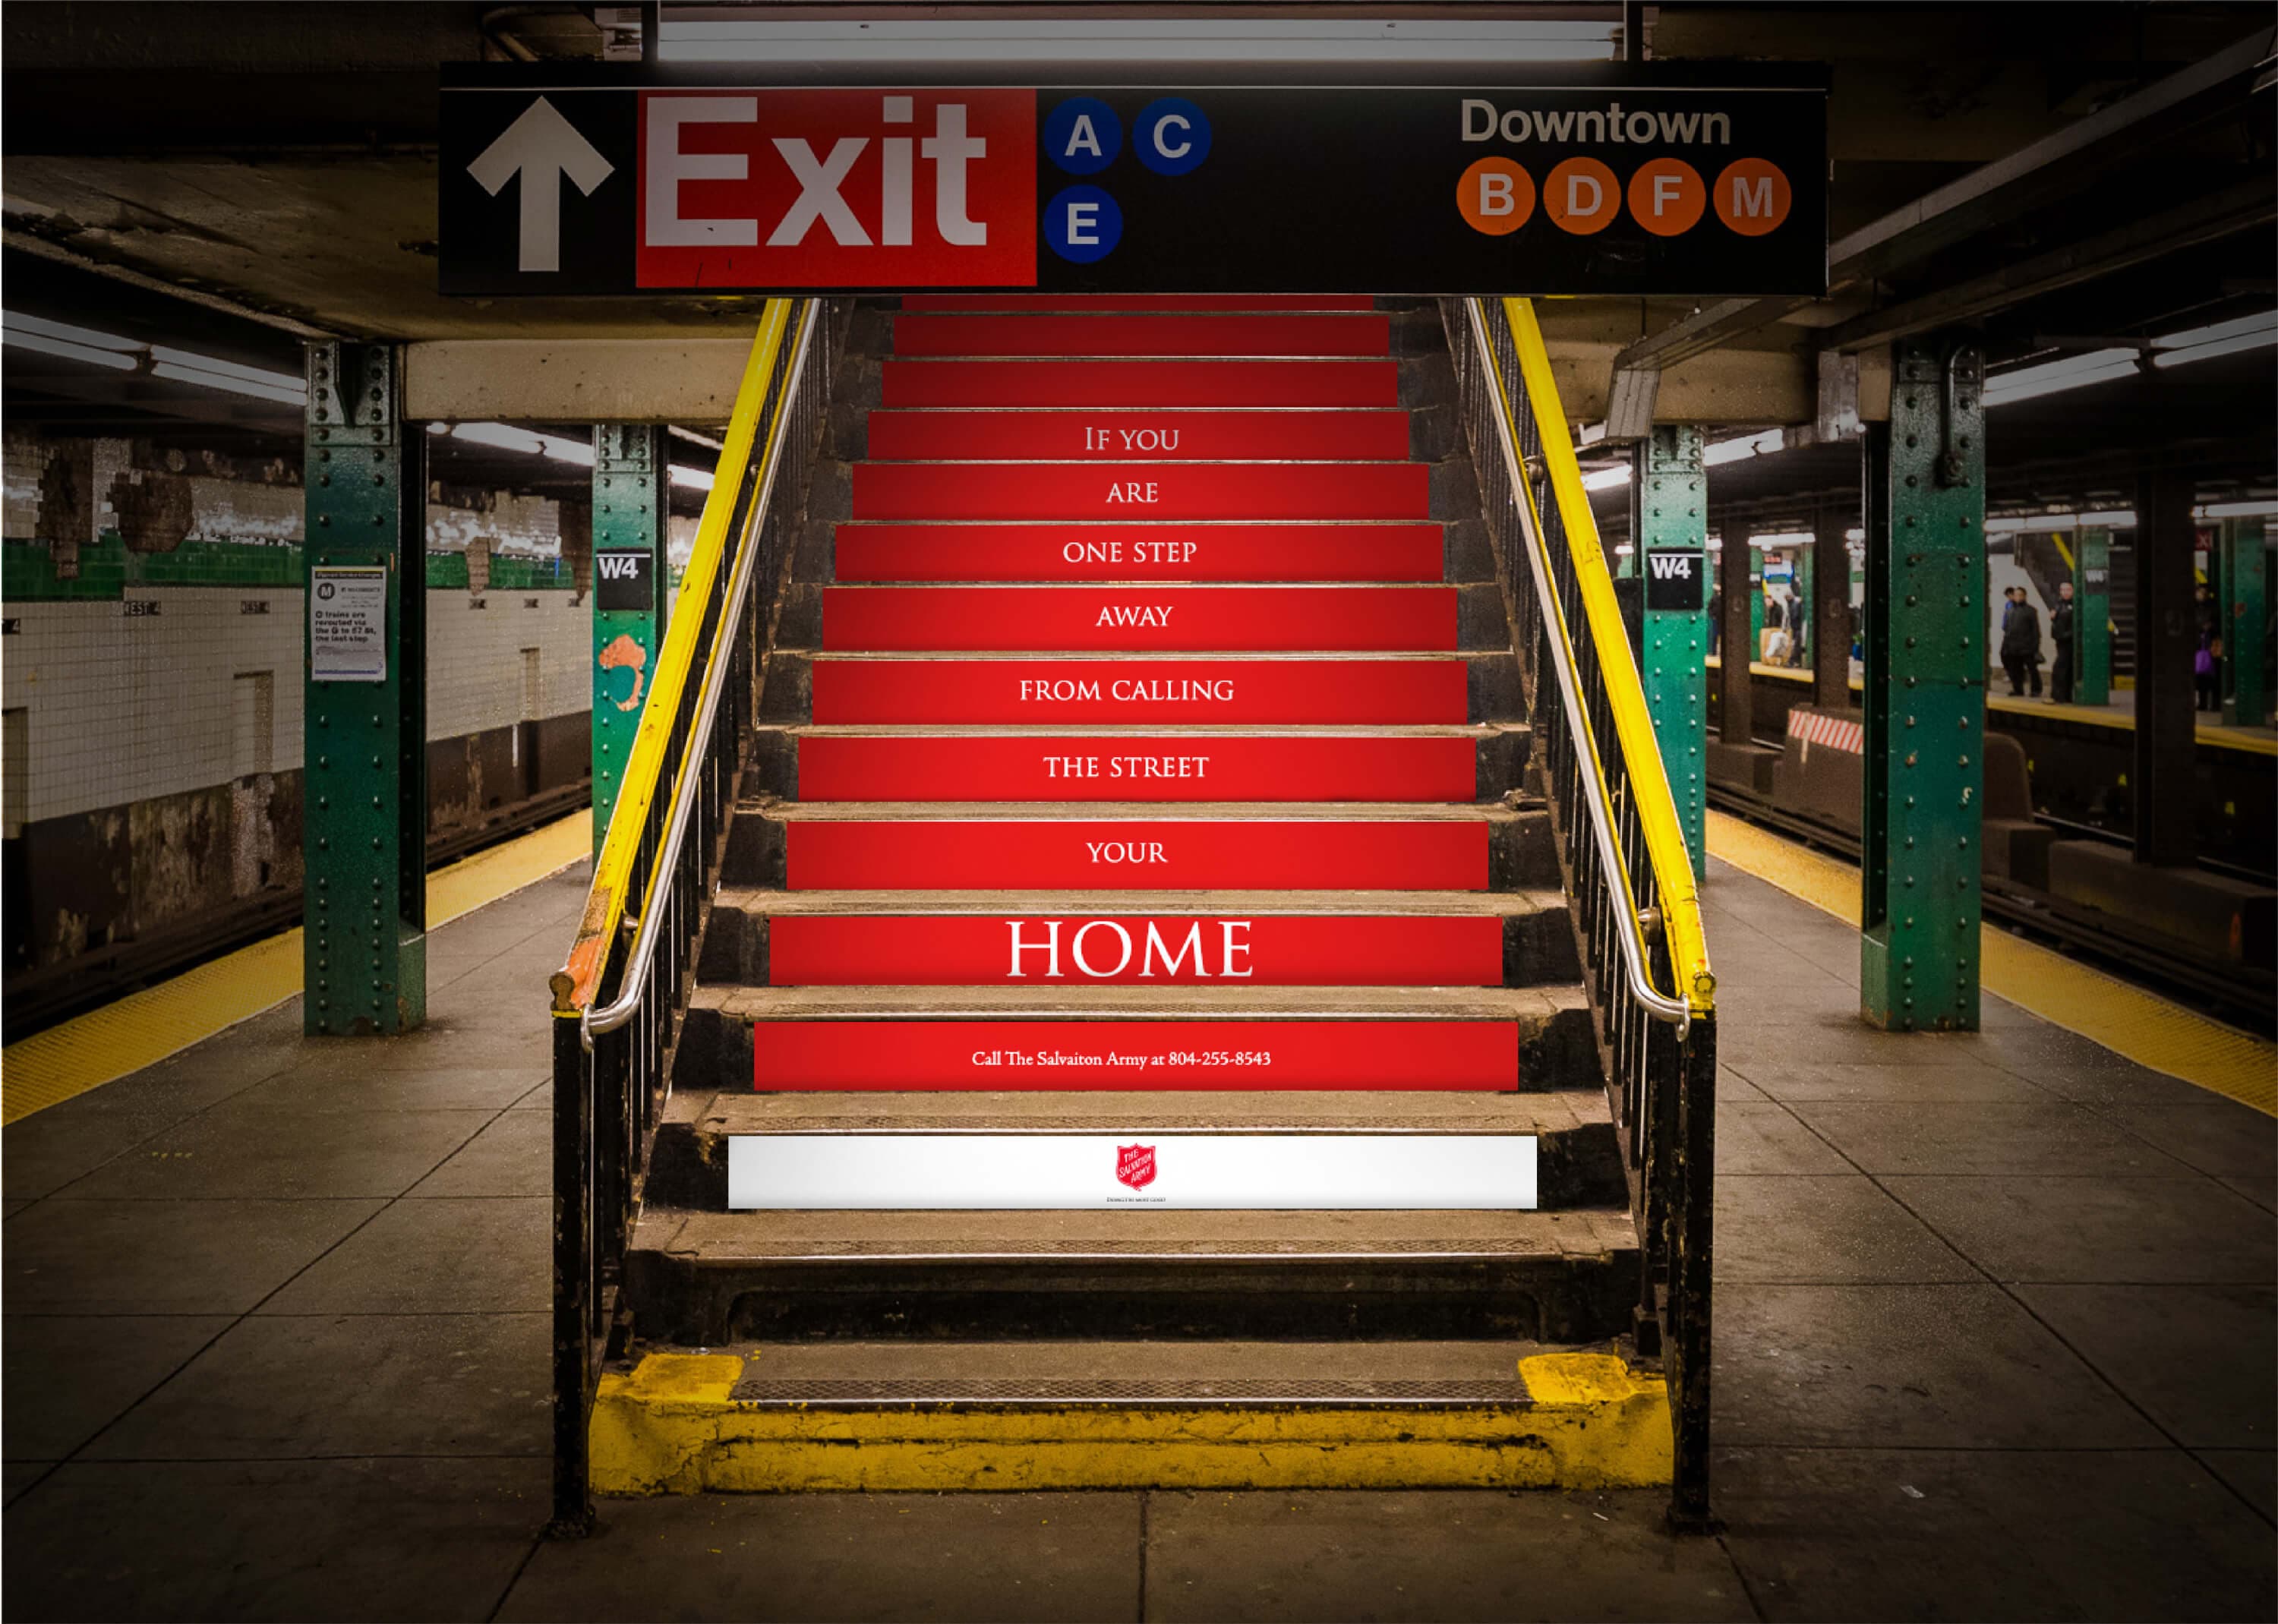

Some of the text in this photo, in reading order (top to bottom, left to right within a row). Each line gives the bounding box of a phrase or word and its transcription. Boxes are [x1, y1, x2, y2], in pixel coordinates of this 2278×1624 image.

[1461, 98, 1731, 145] Downtown
[1065, 114, 1191, 159] A C
[645, 96, 987, 247] Exit
[1478, 173, 1774, 218] B D F M
[1067, 203, 1100, 244] E
[1085, 426, 1179, 452] IF YOU
[1105, 482, 1160, 504] ARE
[1062, 541, 1198, 564] ONE STEP
[598, 557, 639, 580] W4
[1650, 557, 1693, 580] W4
[1095, 606, 1174, 628] AWAY
[1020, 680, 1235, 702] FROM CALLING
[1042, 756, 1211, 779] THE STREET
[1086, 842, 1169, 865] YOUR
[1005, 920, 1254, 978] HOME
[972, 1050, 1272, 1071] Call The Salvaiton Army at 804-255-8543
[1124, 1148, 1139, 1163] THE
